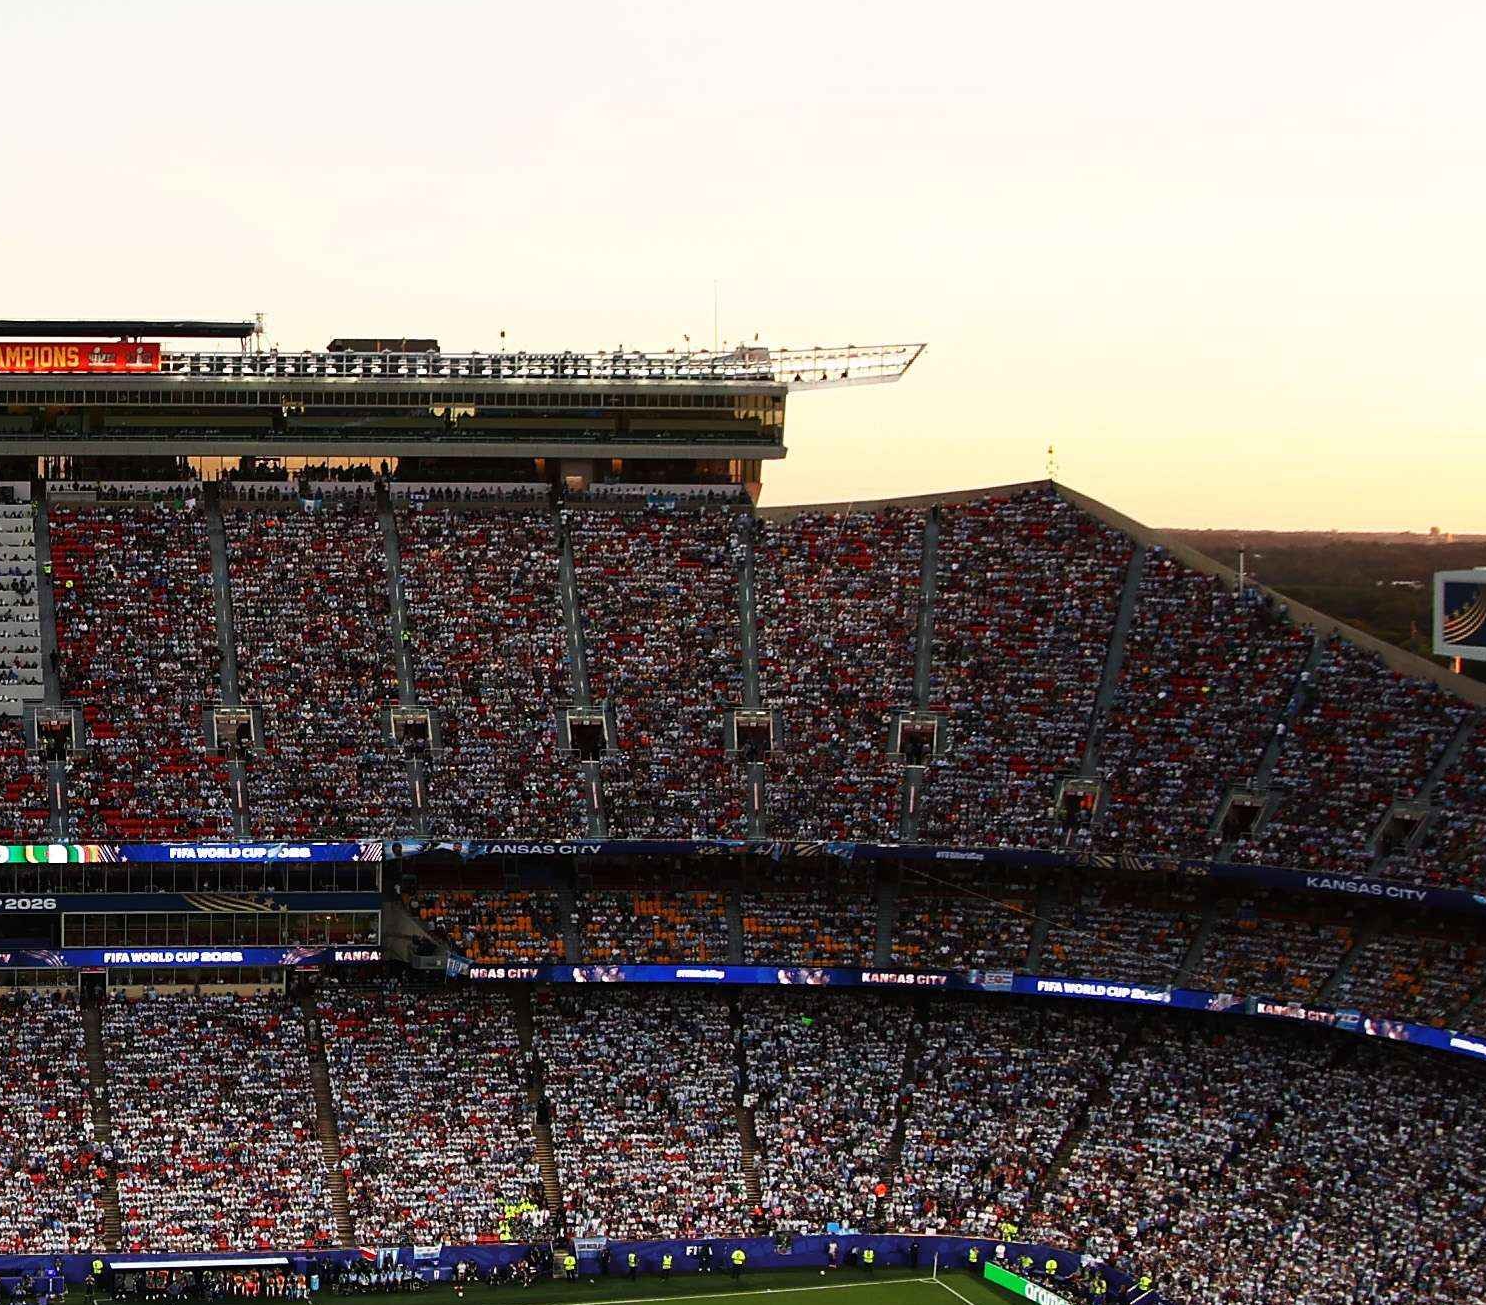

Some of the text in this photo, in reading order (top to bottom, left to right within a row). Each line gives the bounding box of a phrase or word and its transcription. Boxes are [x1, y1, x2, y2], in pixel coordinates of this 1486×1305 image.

[170, 848, 195, 858] FIFA
[196, 848, 240, 858] WORLD
[242, 848, 266, 858] CUP
[564, 845, 601, 855] CITY
[1307, 876, 1428, 902] KANSAS CITY
[5, 898, 57, 910] 2026
[104, 952, 130, 964] FIFA
[131, 952, 174, 963] WORLD
[176, 952, 199, 963] CUP
[335, 951, 380, 962] KANSA
[508, 968, 538, 979] CITY
[862, 972, 947, 986] KANSAS CITY
[1037, 980, 1063, 993] FIFA
[1064, 982, 1106, 996] WORLD
[1106, 986, 1130, 998] CUP
[686, 1245, 713, 1256] FIA
